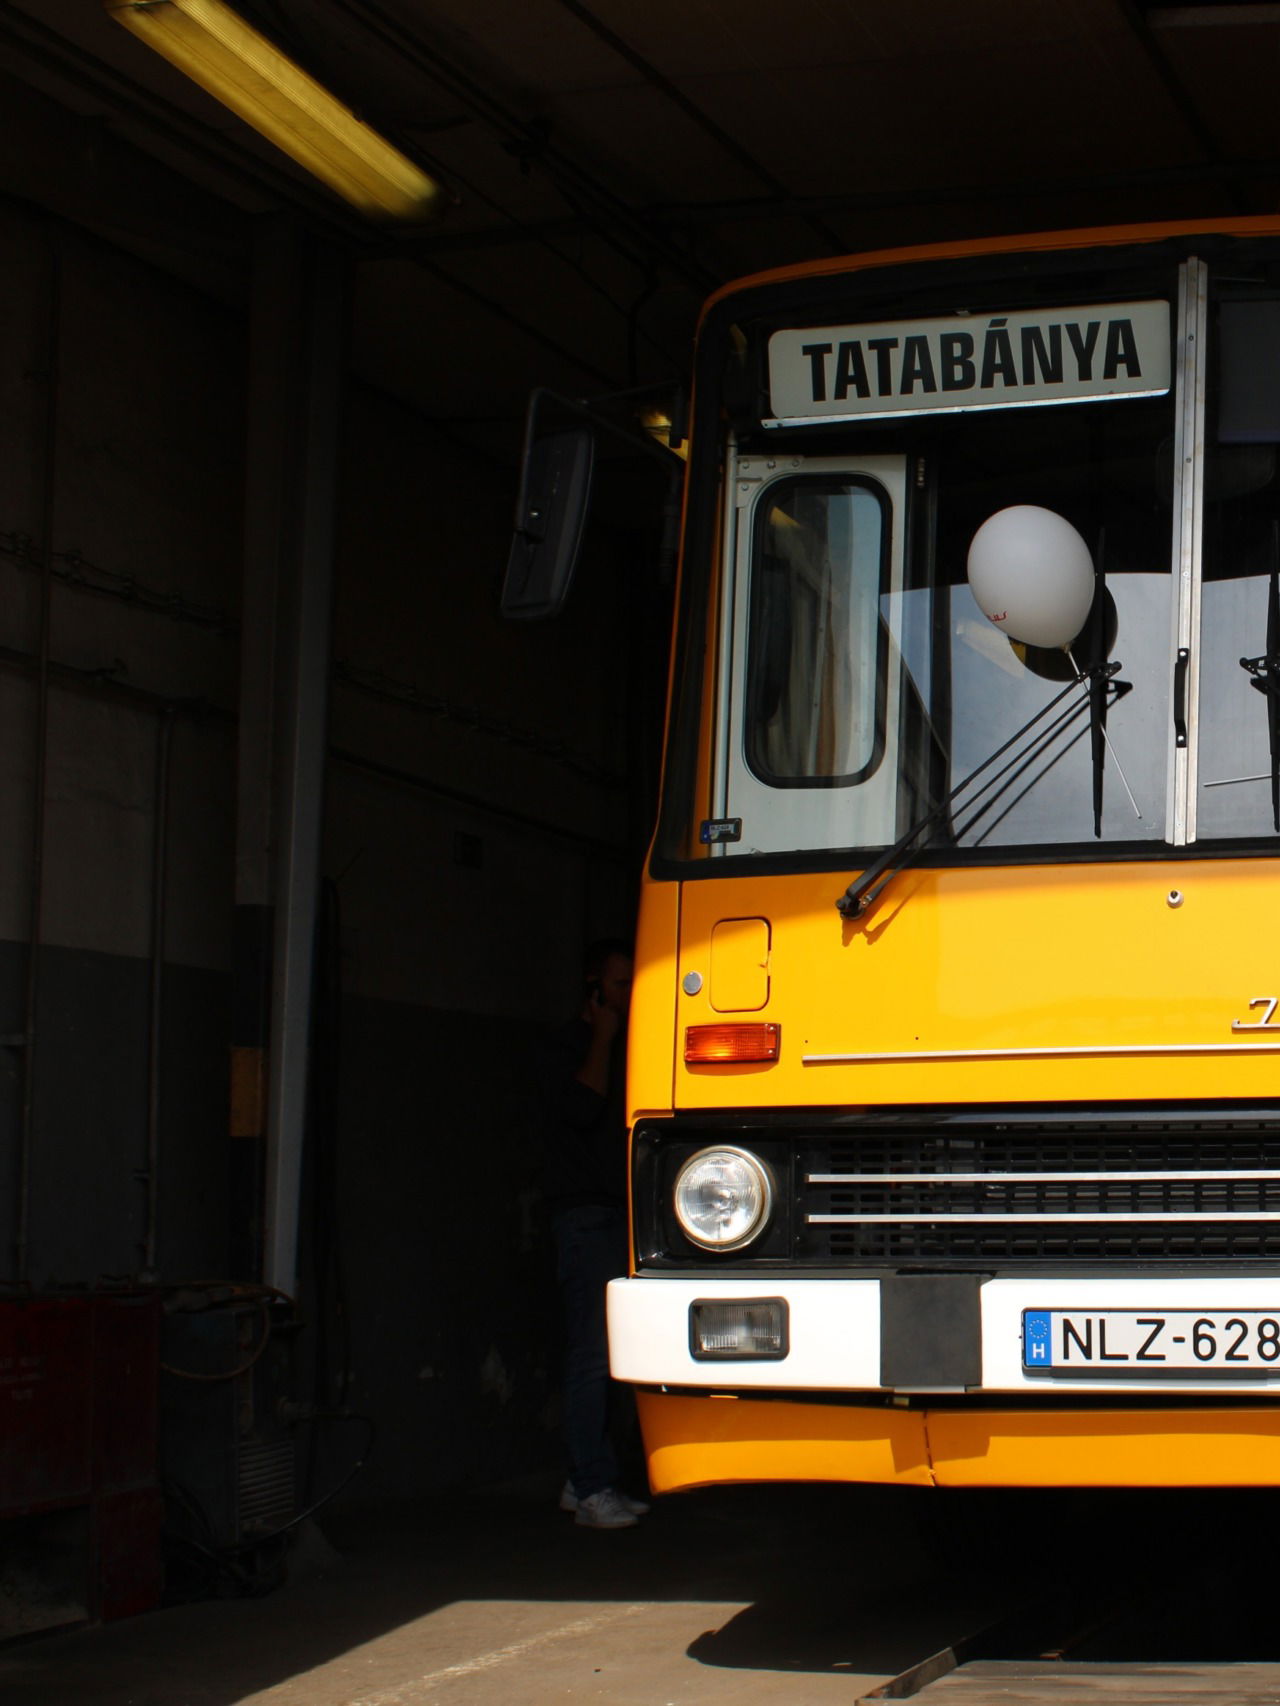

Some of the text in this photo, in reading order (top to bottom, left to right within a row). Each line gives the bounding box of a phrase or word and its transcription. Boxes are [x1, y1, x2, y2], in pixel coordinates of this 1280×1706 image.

[802, 318, 1142, 402] TATABÁNYA
[1032, 1318, 1280, 1362] H NLZ-628
